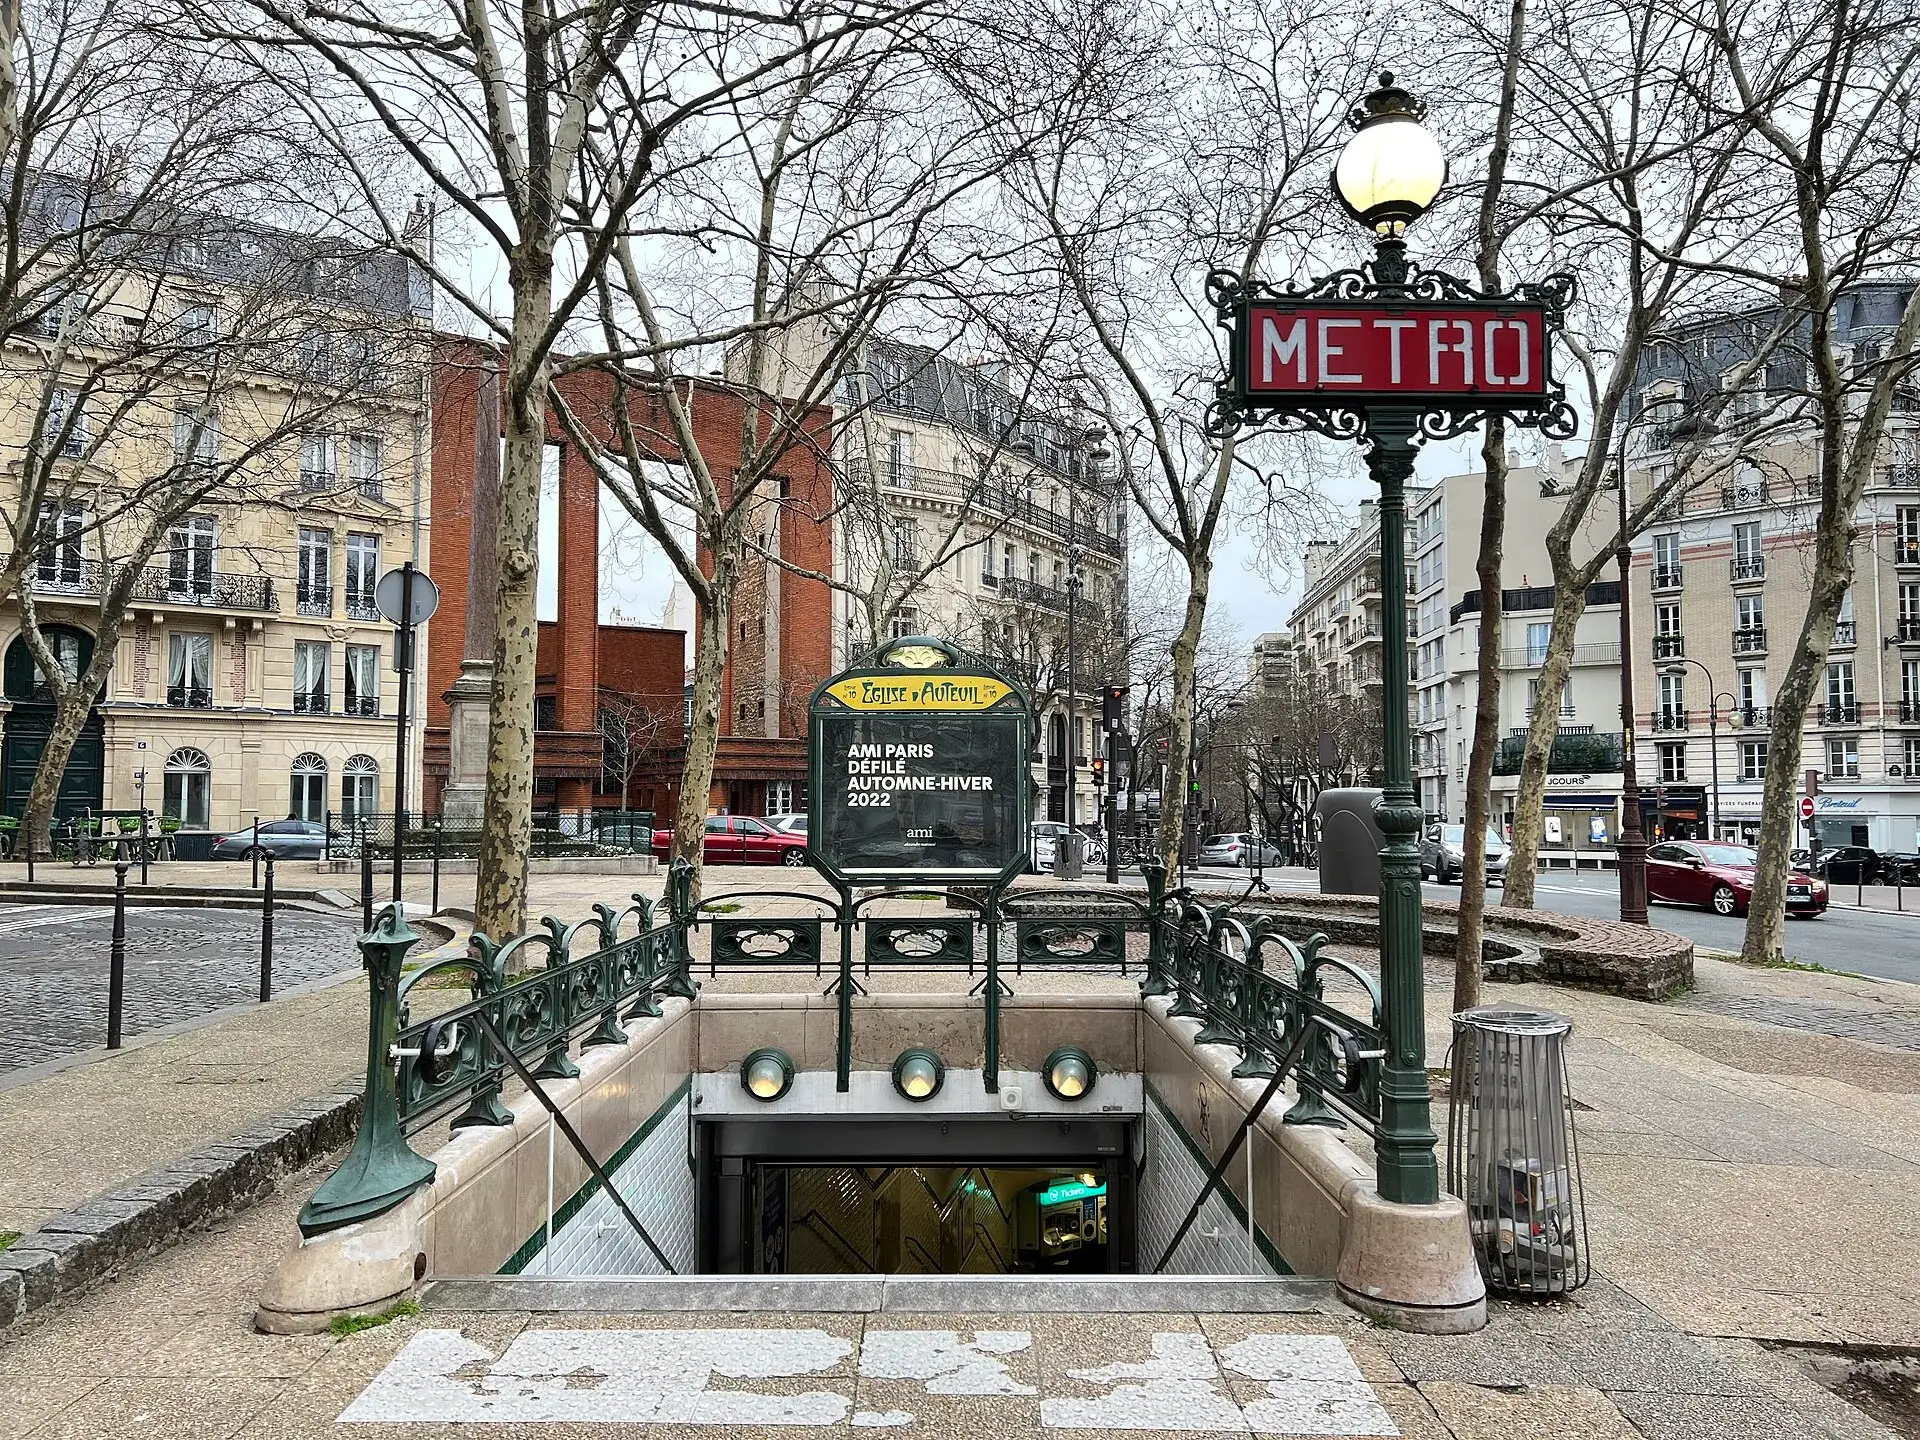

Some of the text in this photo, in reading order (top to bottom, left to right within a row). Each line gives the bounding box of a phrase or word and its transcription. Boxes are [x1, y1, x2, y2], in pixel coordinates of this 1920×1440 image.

[1262, 317, 1530, 385] METRO
[848, 690, 857, 699] 10
[989, 690, 997, 698] 10
[847, 743, 934, 758] AMI PARIS
[847, 758, 906, 774] DÉFILÉ
[847, 776, 993, 791] AUTOMNE-HIVER
[847, 792, 891, 807] 2022
[906, 825, 933, 838] ami
